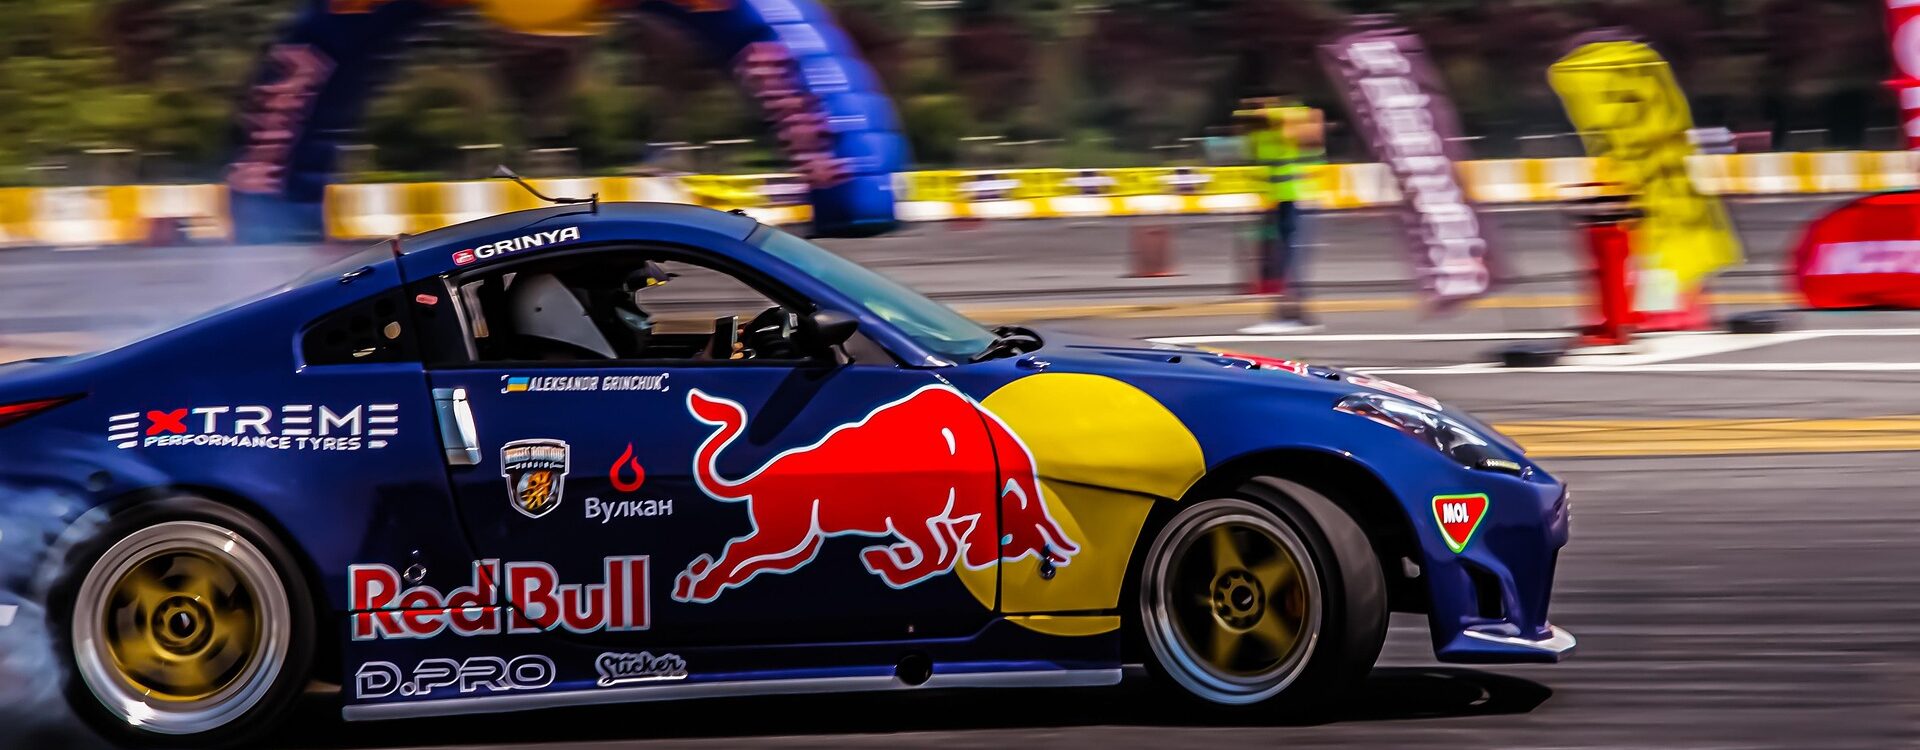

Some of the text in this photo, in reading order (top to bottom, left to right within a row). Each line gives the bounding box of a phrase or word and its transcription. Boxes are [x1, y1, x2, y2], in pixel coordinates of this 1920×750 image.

[474, 226, 580, 259] GRINYA
[527, 375, 664, 392] ALEKSANDR GRINCHUK
[144, 434, 361, 450] PERFORMANCE TYRES
[585, 497, 673, 524] Вулкан
[1442, 502, 1470, 524] MOL
[348, 555, 651, 641] Red Bull
[355, 654, 556, 699] D.PRO
[595, 651, 687, 684] Sticker
